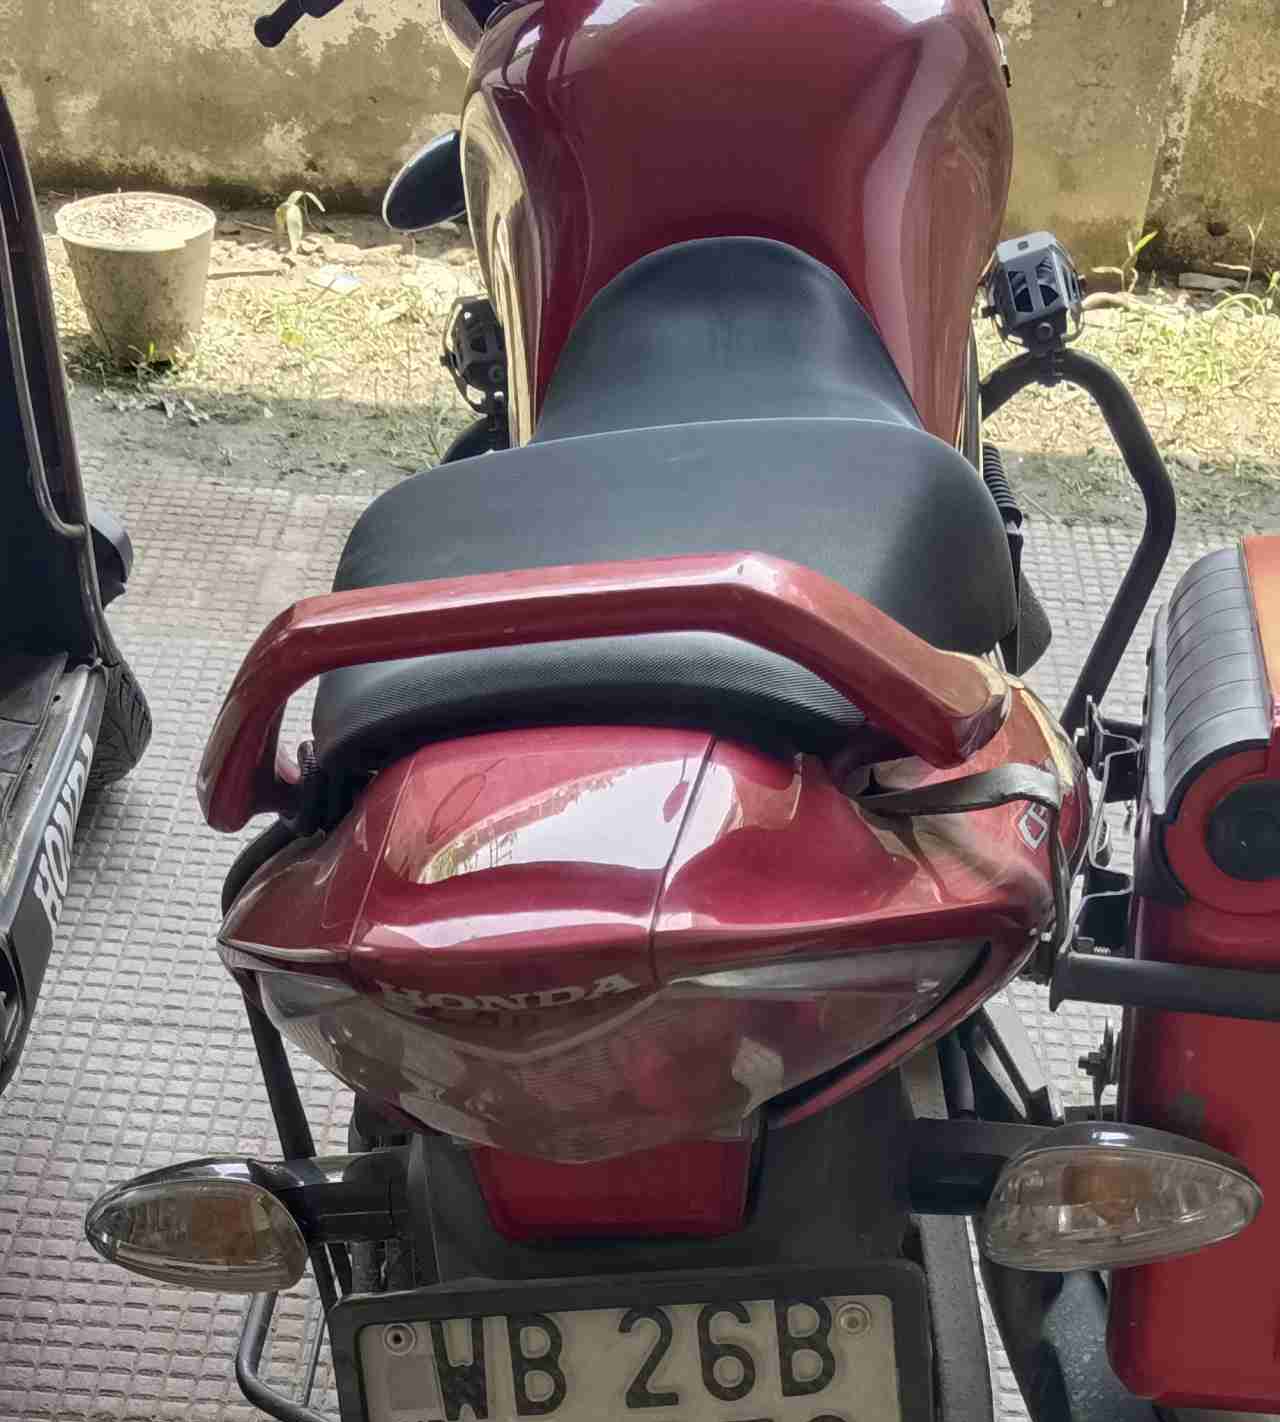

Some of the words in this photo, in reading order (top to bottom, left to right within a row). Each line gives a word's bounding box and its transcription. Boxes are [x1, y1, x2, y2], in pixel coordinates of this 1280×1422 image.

[375, 973, 640, 1011] HONDA
[429, 1312, 567, 1422] WB
[616, 1299, 836, 1409] 26B
